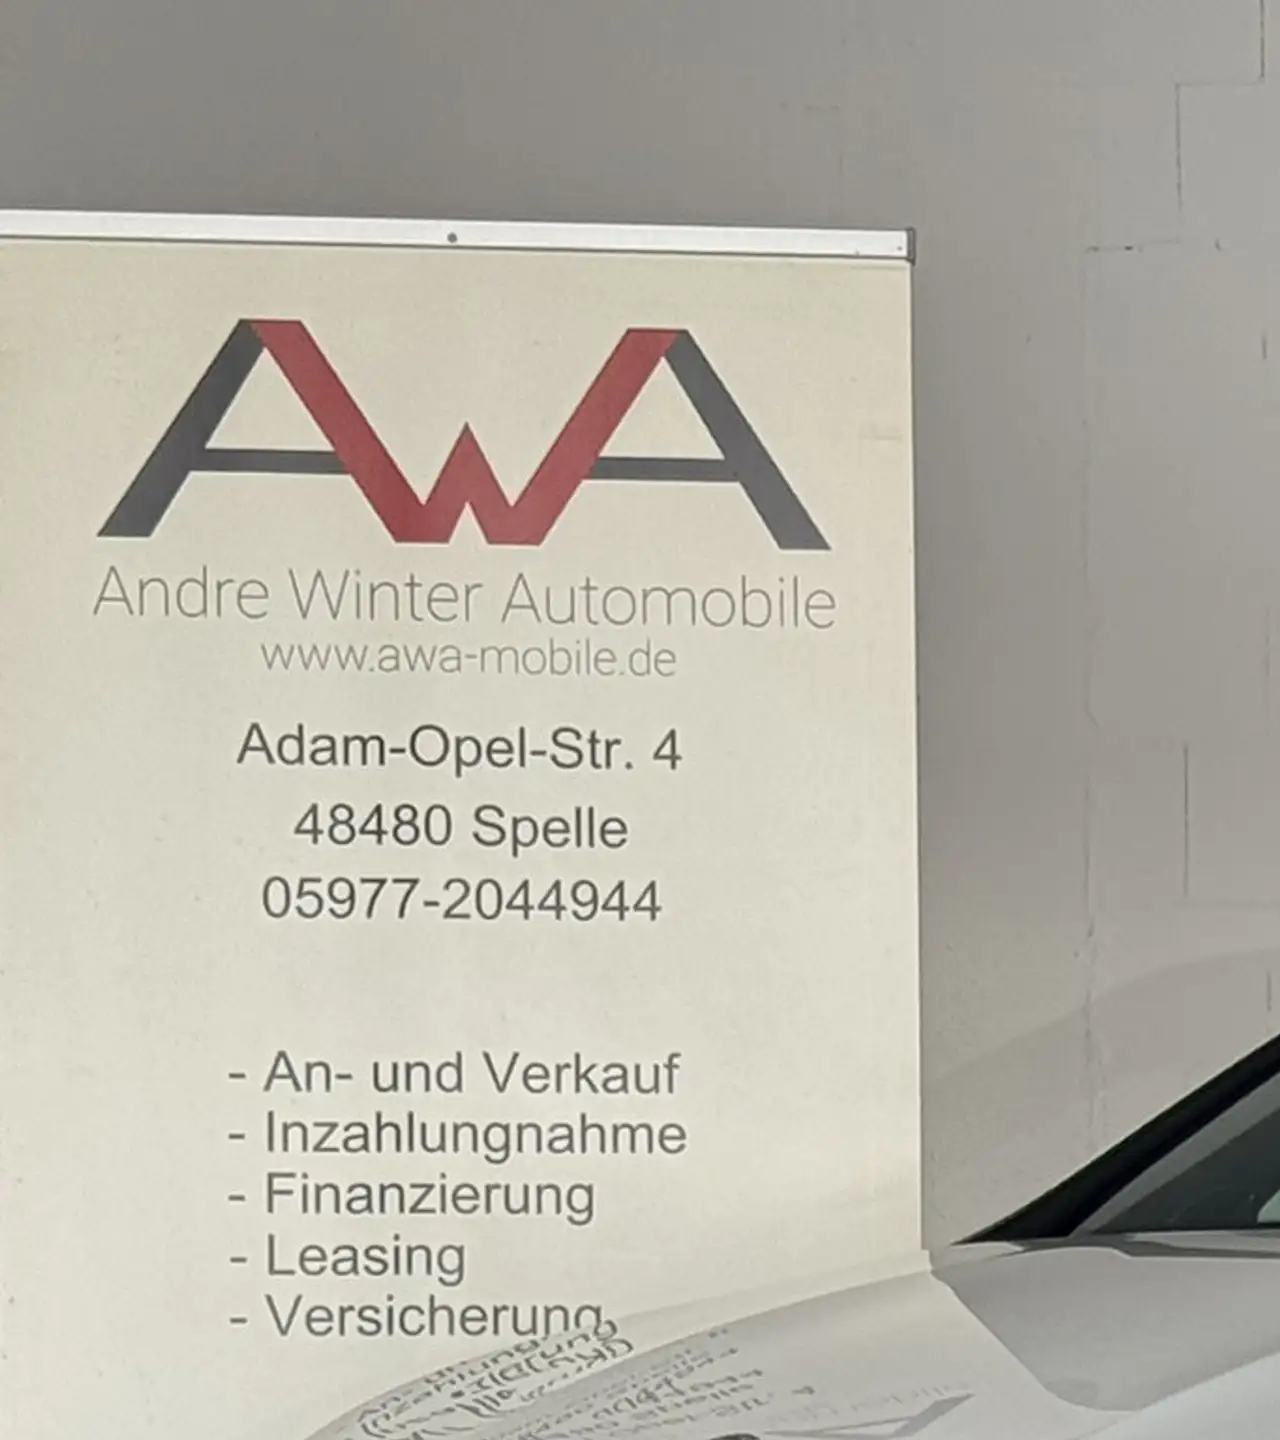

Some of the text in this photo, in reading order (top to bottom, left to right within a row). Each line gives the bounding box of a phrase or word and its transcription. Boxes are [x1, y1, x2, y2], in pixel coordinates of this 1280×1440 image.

[92, 564, 836, 630] Andre Winter Automobile
[260, 637, 677, 678] www.awa-mobile.de
[235, 721, 683, 779] Adam-Opel-Str. 4
[293, 802, 629, 859] 48480 Spelle
[261, 875, 663, 923] 05977-2044944
[262, 1049, 354, 1094] An-
[372, 1050, 464, 1094] und
[481, 1050, 683, 1095] Verkauf
[266, 1109, 687, 1166] Inzahlungnahme
[266, 1171, 594, 1227] Finanzierung
[267, 1232, 466, 1288] Leasing
